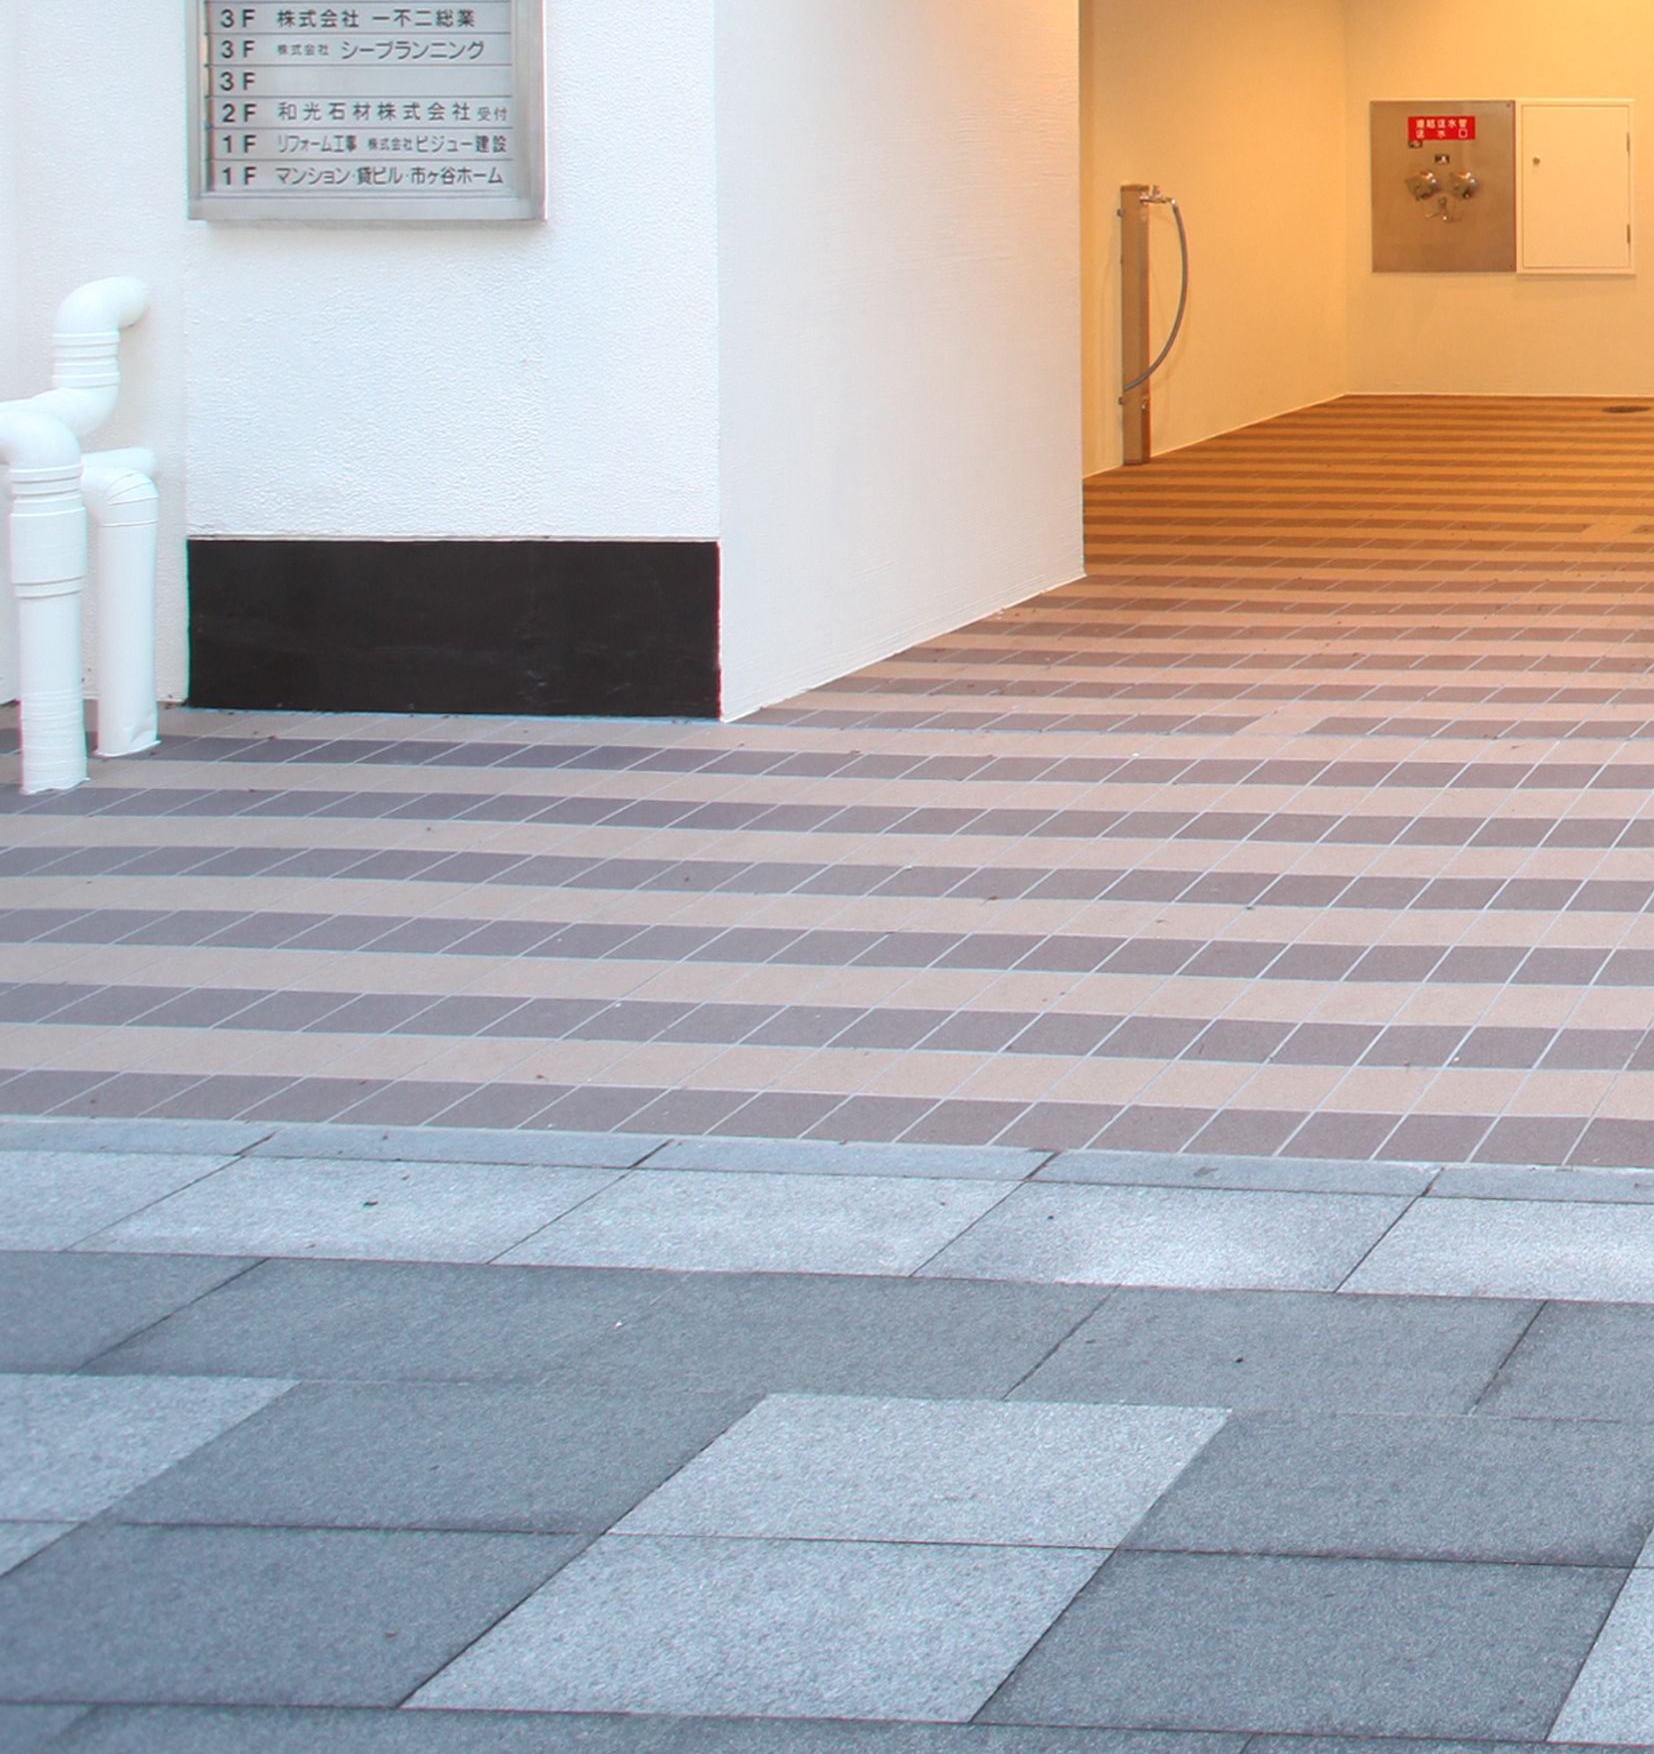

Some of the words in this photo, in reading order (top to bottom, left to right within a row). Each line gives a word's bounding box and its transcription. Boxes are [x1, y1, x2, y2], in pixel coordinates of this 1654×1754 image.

[278, 101, 472, 122] 和光石材株式会社
